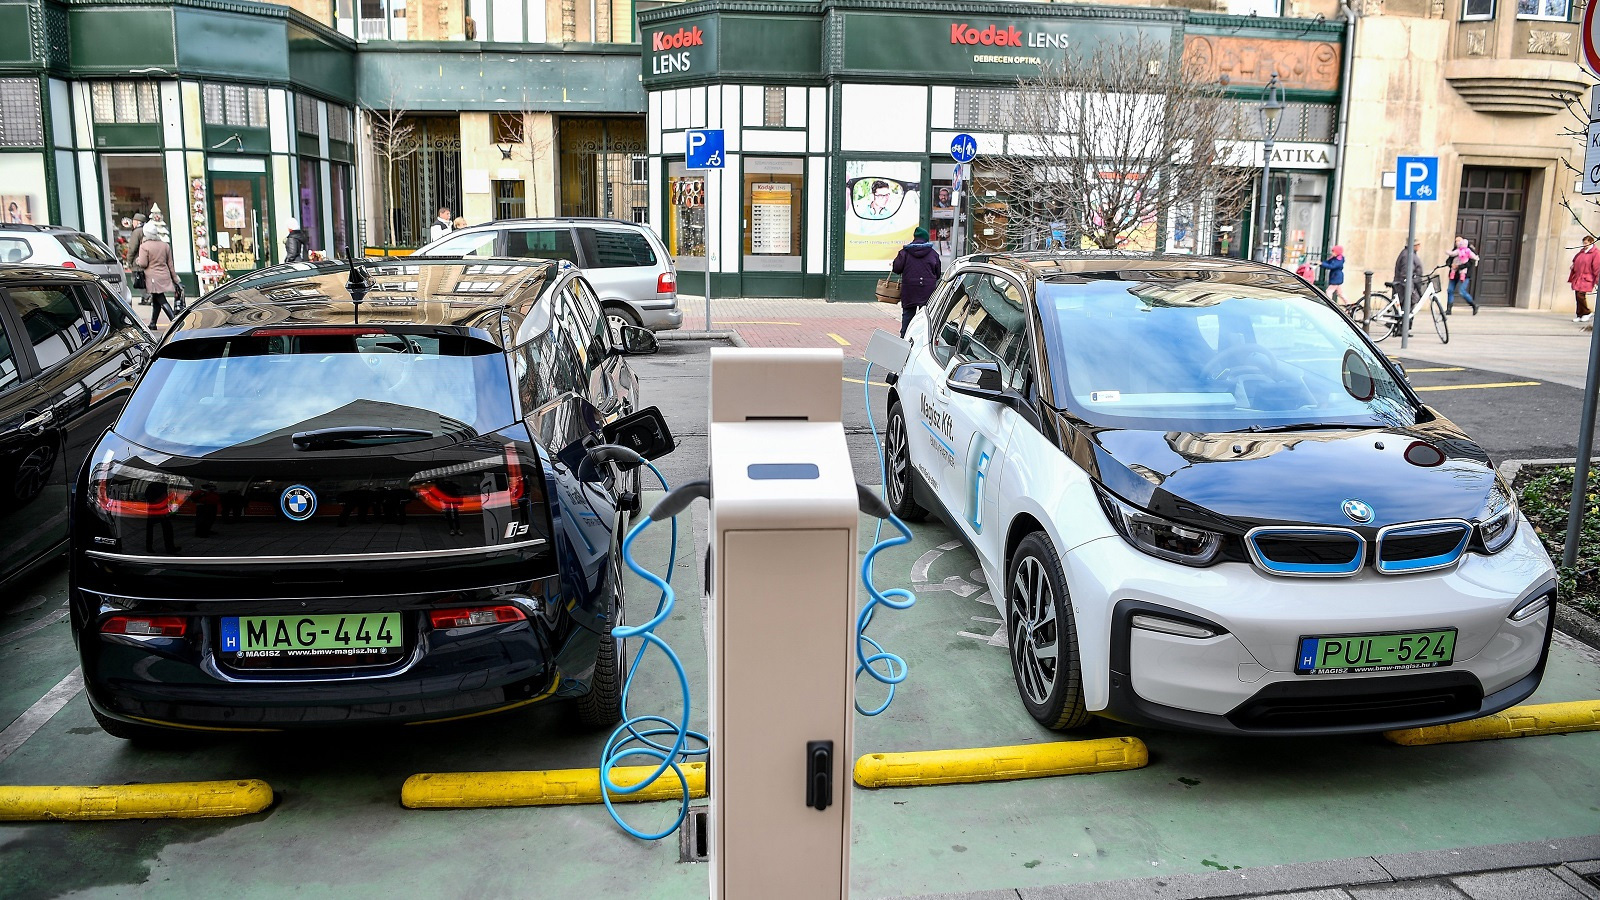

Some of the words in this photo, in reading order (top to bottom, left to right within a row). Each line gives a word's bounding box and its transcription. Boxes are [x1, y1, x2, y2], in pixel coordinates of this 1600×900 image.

[652, 25, 703, 52] Kodak
[950, 23, 1022, 47] Kodak
[1028, 32, 1069, 49] LENS
[652, 51, 691, 75] LENS
[973, 54, 1013, 64] DEBRECEN
[1013, 57, 1041, 65] OPTIKA
[689, 132, 706, 156] P
[1262, 148, 1329, 163] ATIKA
[1404, 162, 1428, 196] P
[920, 392, 942, 430] Magisz
[941, 410, 954, 442] Kft.
[504, 521, 530, 539] i3
[227, 636, 236, 647] H
[246, 616, 393, 648] MAG-444
[245, 650, 281, 658] MAGISZ
[287, 648, 378, 656] www.bmw-magisz.hu
[1303, 656, 1312, 665] H
[1321, 635, 1446, 666] PUL-524
[1354, 662, 1431, 673] www.bmw-magisz.hu
